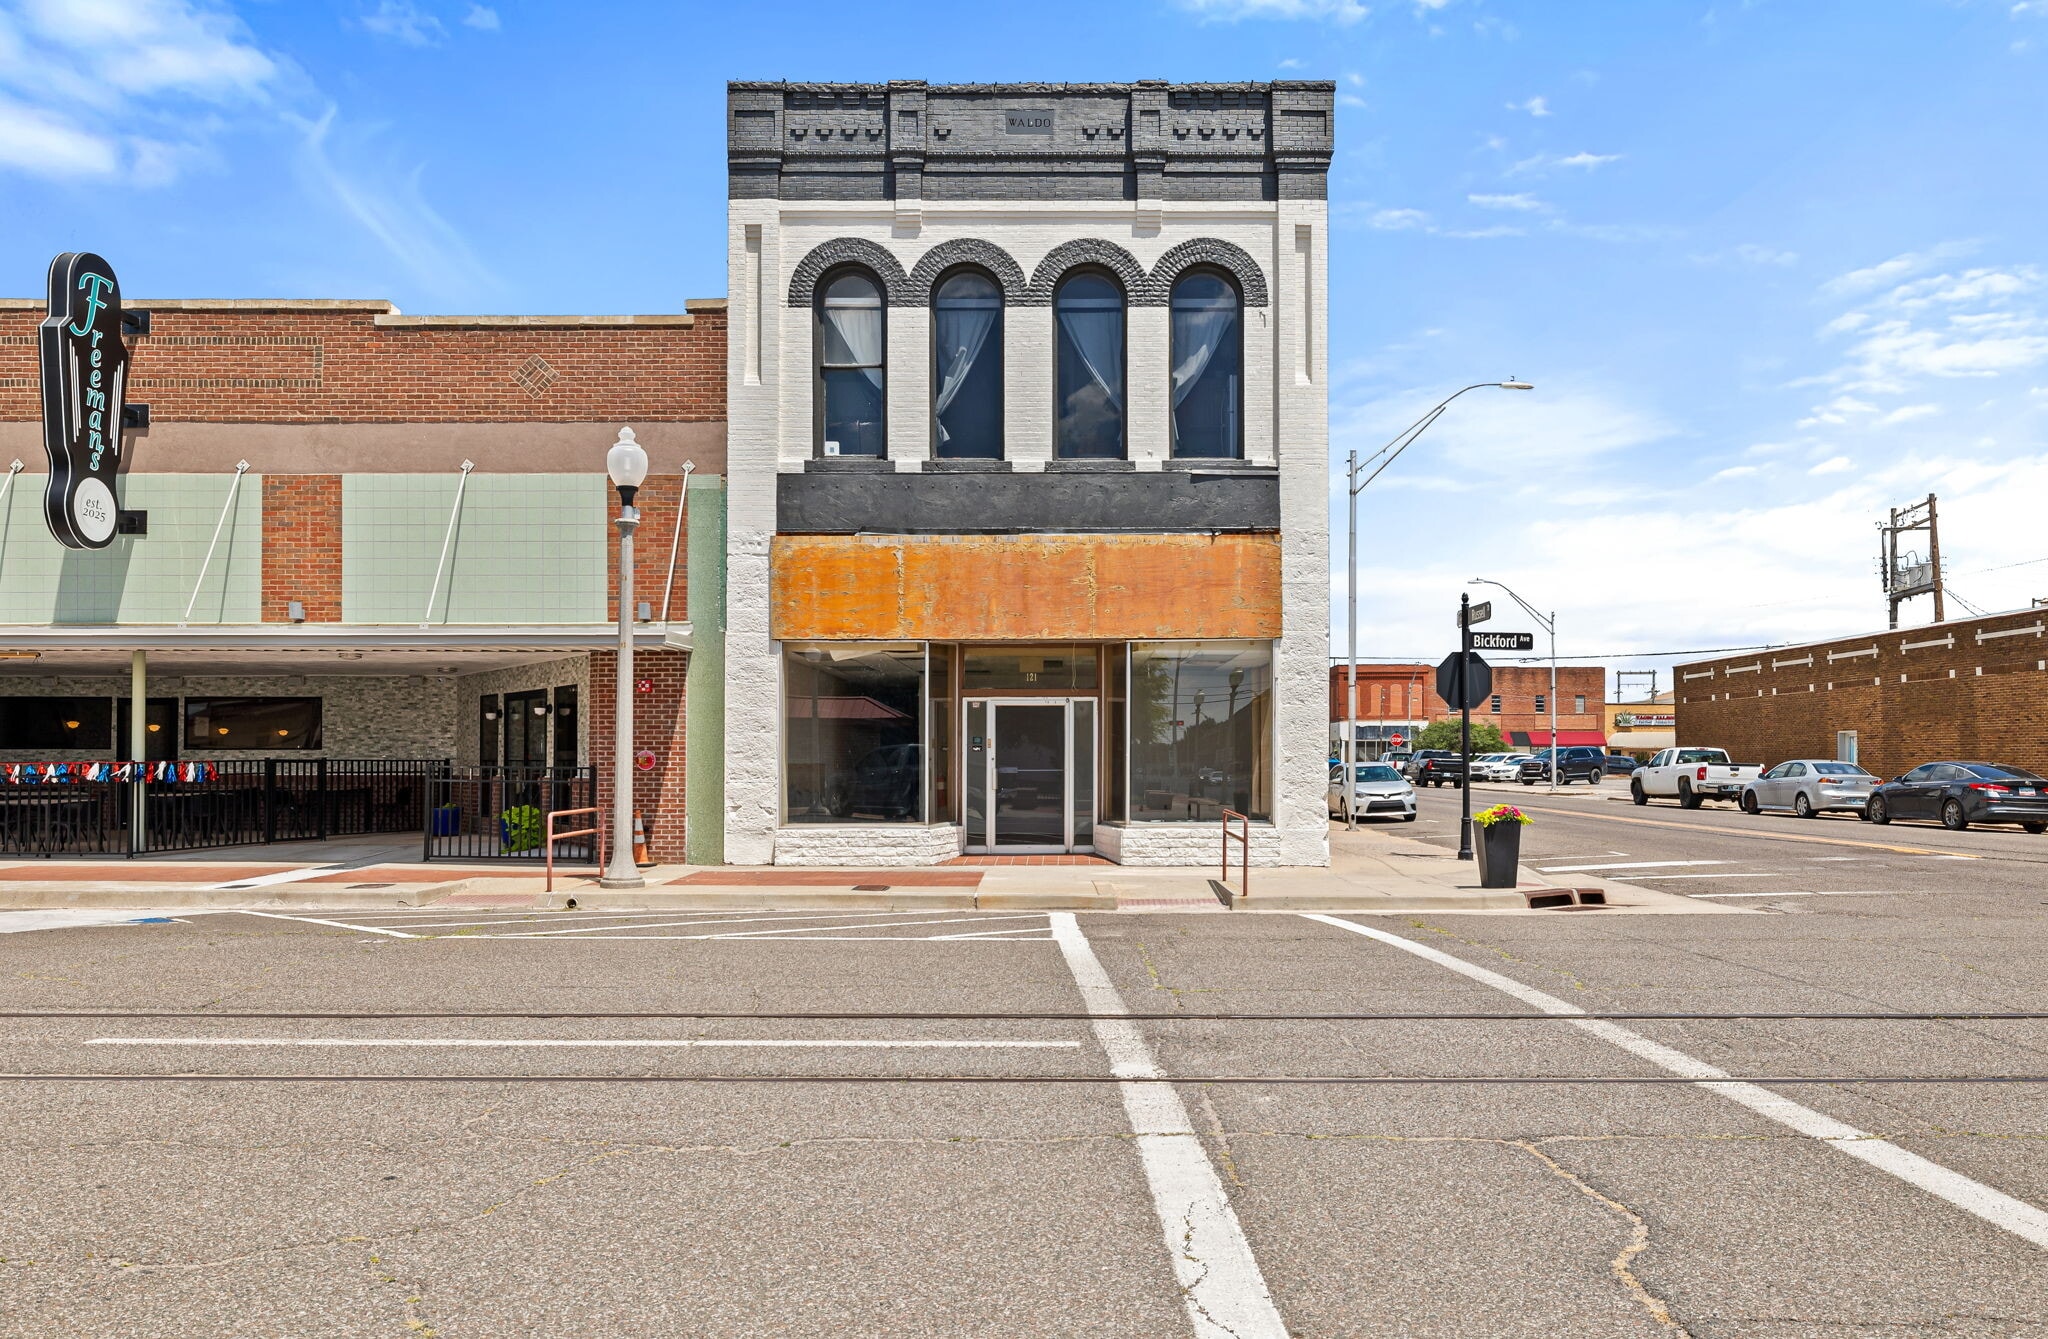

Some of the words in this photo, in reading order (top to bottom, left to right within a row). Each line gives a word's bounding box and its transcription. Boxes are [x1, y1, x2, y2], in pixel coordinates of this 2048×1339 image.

[1008, 118, 1051, 128] WALDO
[86, 498, 102, 510] est.
[82, 507, 106, 523] 2025
[1473, 634, 1517, 648] Bickford
[1026, 672, 1037, 682] 121
